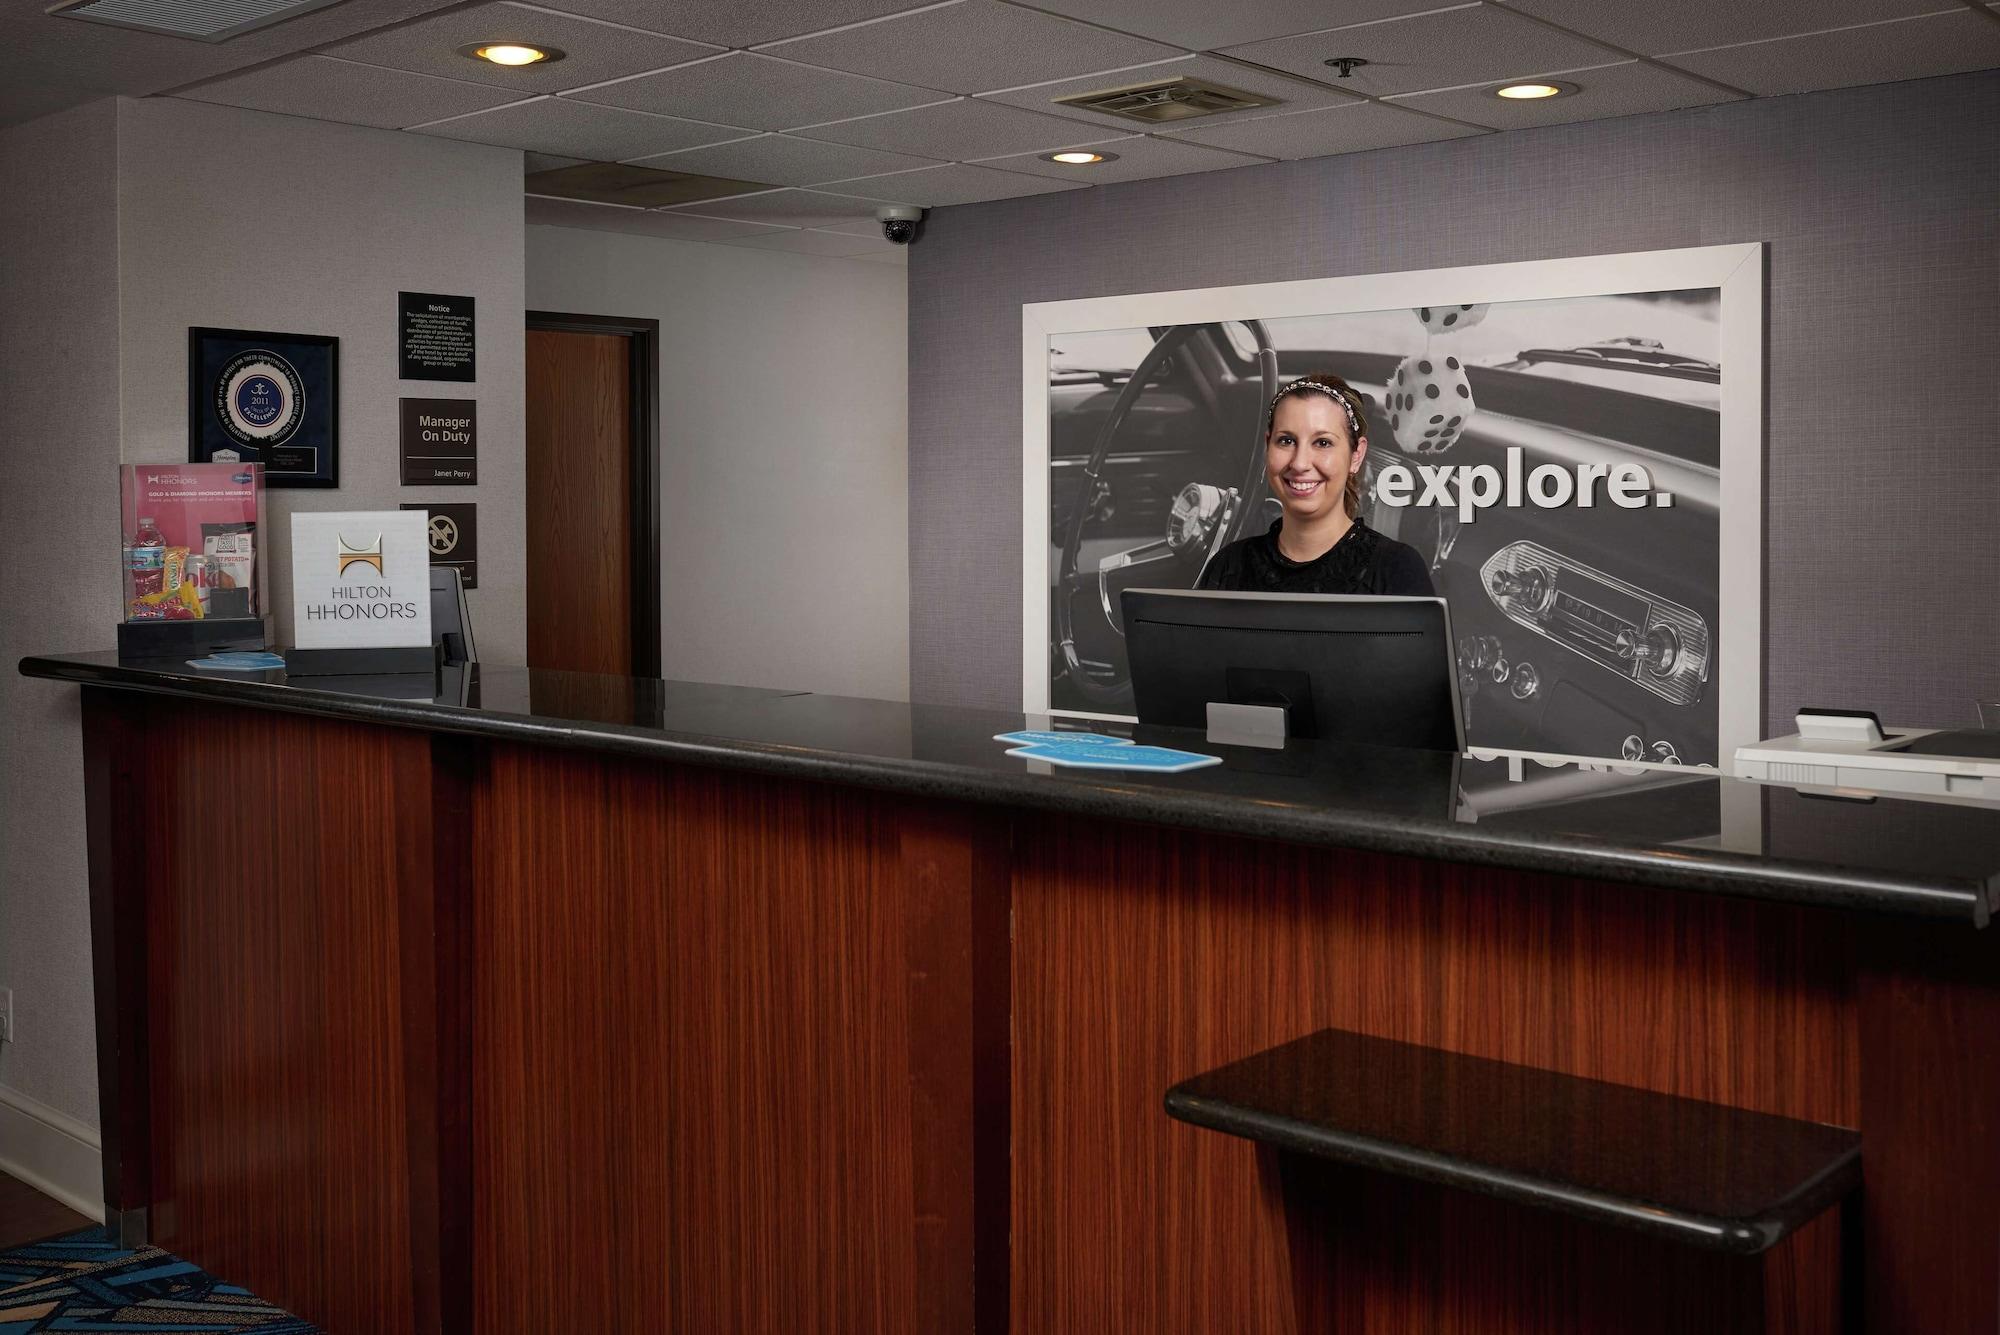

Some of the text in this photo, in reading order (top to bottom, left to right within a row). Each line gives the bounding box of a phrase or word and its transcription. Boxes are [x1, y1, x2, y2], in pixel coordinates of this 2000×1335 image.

[428, 304, 450, 312] Notice
[244, 407, 276, 420] EXCELLENCE
[419, 415, 471, 430] Manager
[422, 430, 471, 444] On Duty
[454, 470, 471, 479] Perry
[1376, 446, 1674, 523] explore.
[332, 586, 391, 599] HILTON
[307, 602, 416, 620] HHONORS
